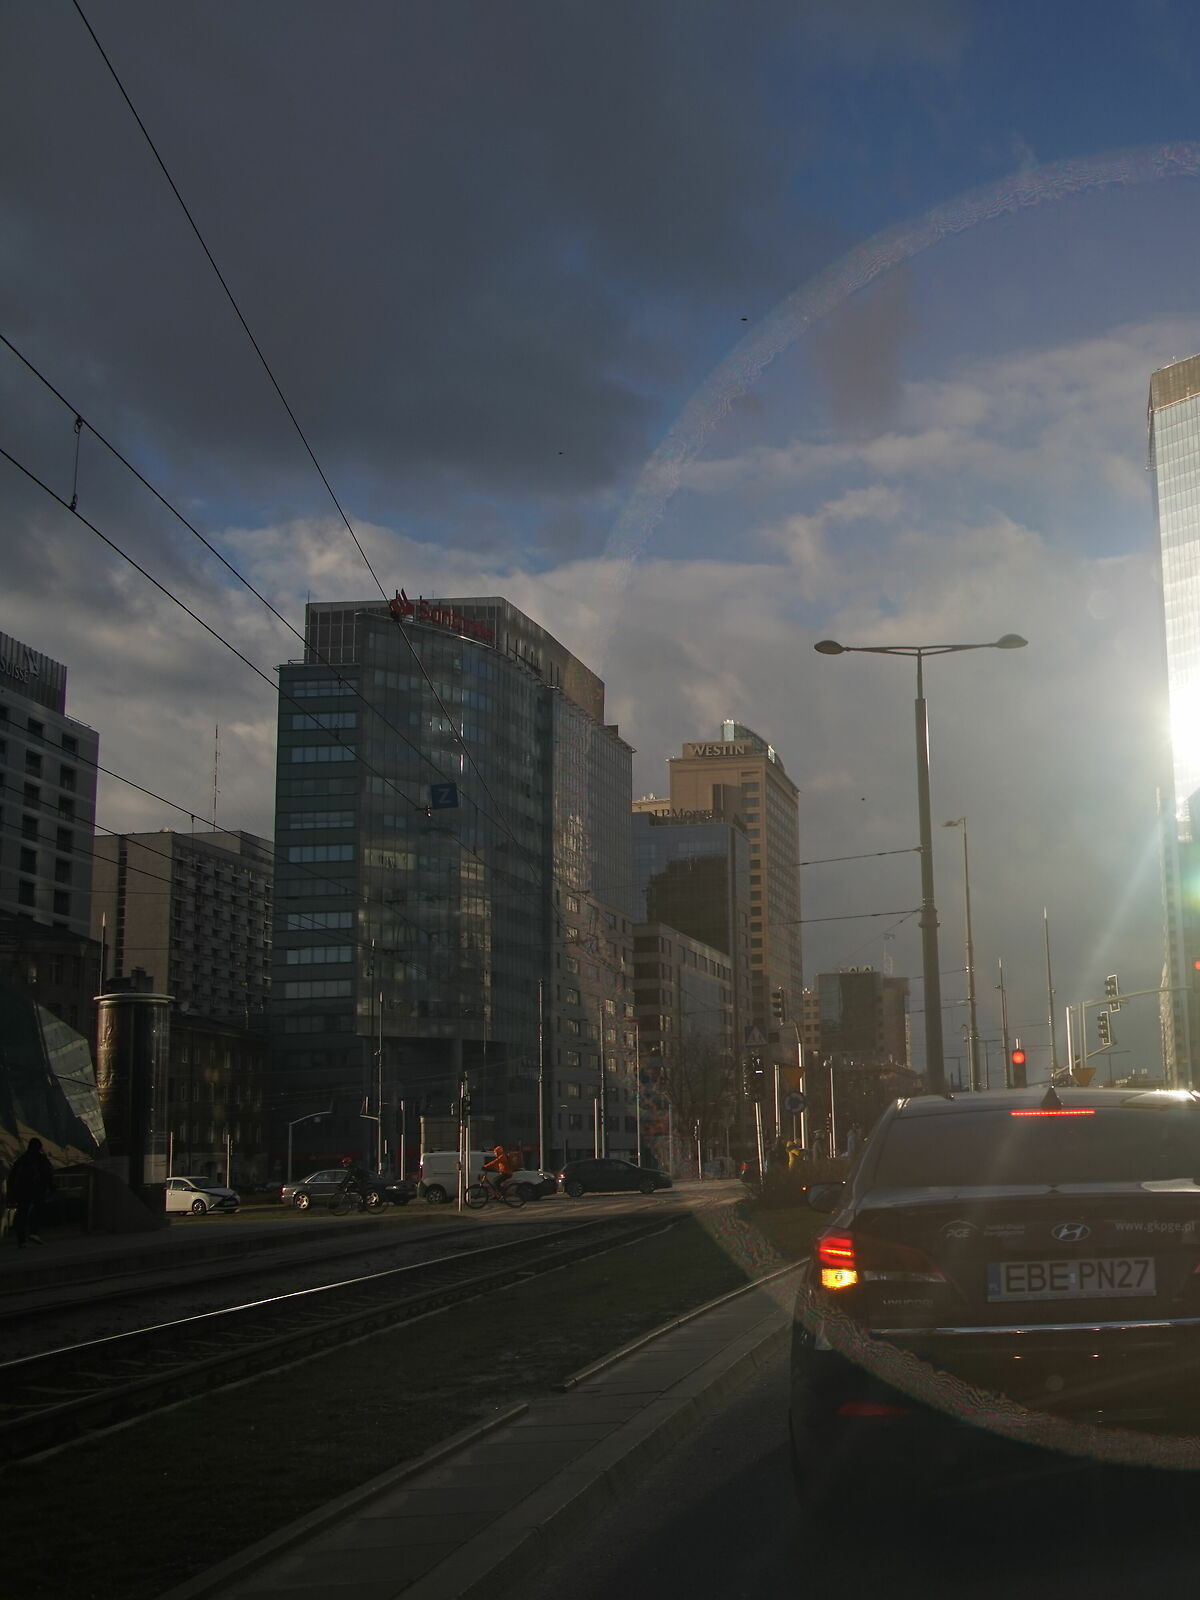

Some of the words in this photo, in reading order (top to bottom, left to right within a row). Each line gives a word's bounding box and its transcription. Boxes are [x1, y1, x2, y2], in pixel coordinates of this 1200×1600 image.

[419, 600, 495, 642] Santander
[690, 743, 745, 757] WESTIN
[1114, 1219, 1196, 1233] www.gkpge.pl
[1006, 1263, 1069, 1293] EBE
[1079, 1259, 1149, 1290] PN27
